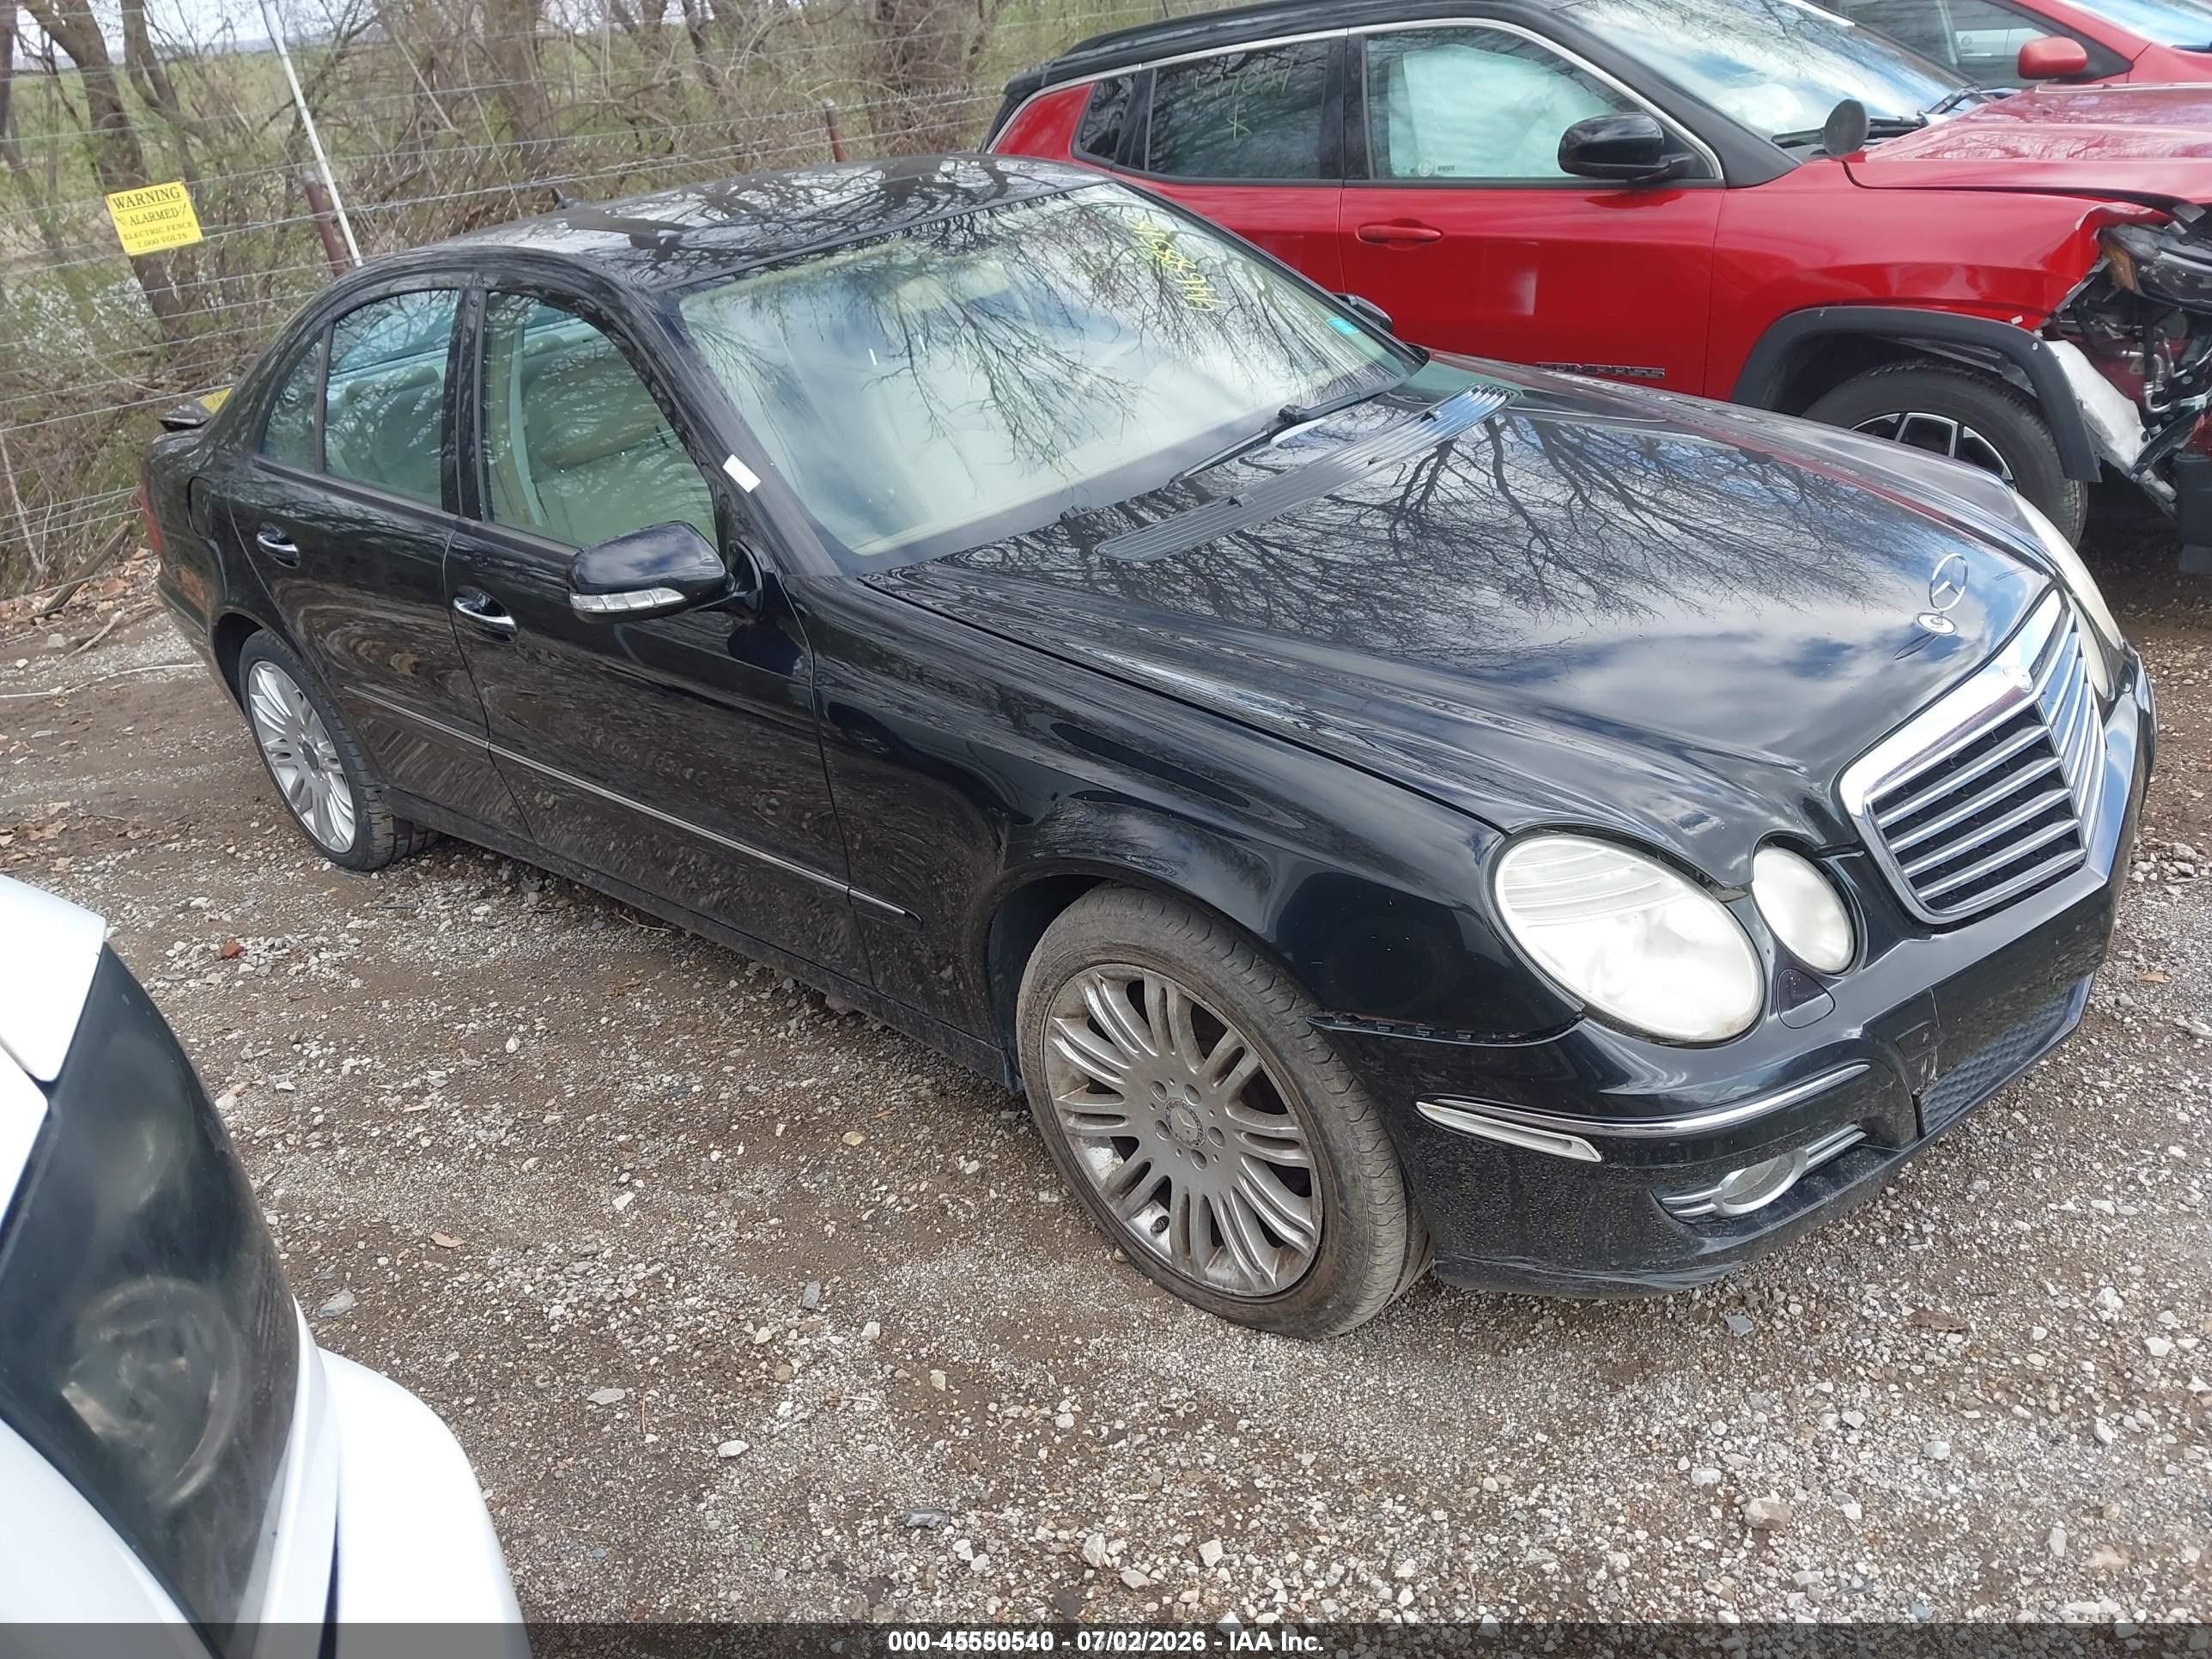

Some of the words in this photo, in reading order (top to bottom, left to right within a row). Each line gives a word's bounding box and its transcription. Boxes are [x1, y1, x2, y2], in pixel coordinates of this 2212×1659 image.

[113, 186, 180, 210] WARNING
[130, 207, 179, 226] ALARMED
[124, 227, 164, 240] ELECTRIC
[167, 222, 194, 232] FENCE
[163, 233, 188, 243] VOLTS
